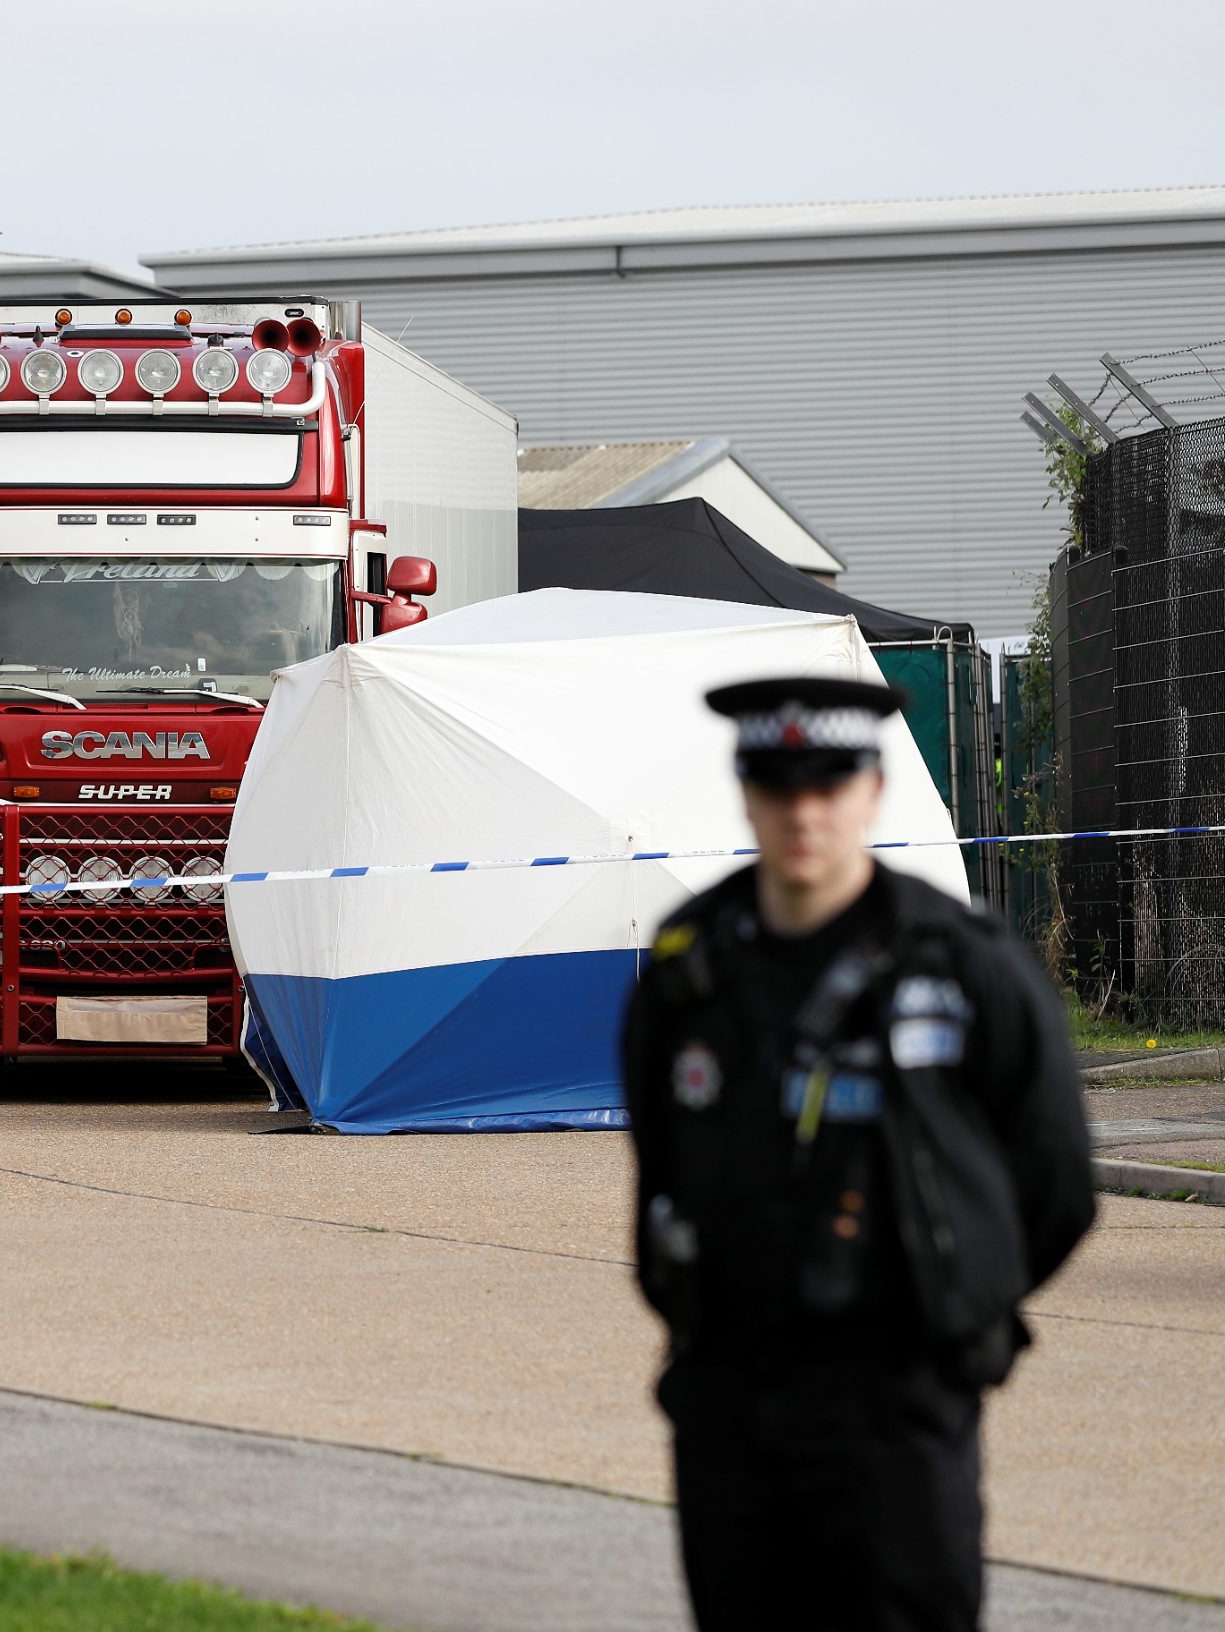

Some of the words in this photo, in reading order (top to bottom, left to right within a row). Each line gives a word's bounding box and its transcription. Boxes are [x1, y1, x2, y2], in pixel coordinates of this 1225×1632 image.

[62, 667, 84, 682] The
[89, 667, 145, 680] Ultimate
[150, 664, 191, 680] Dream
[40, 730, 211, 760] SCANIA
[78, 784, 172, 800] SUPER
